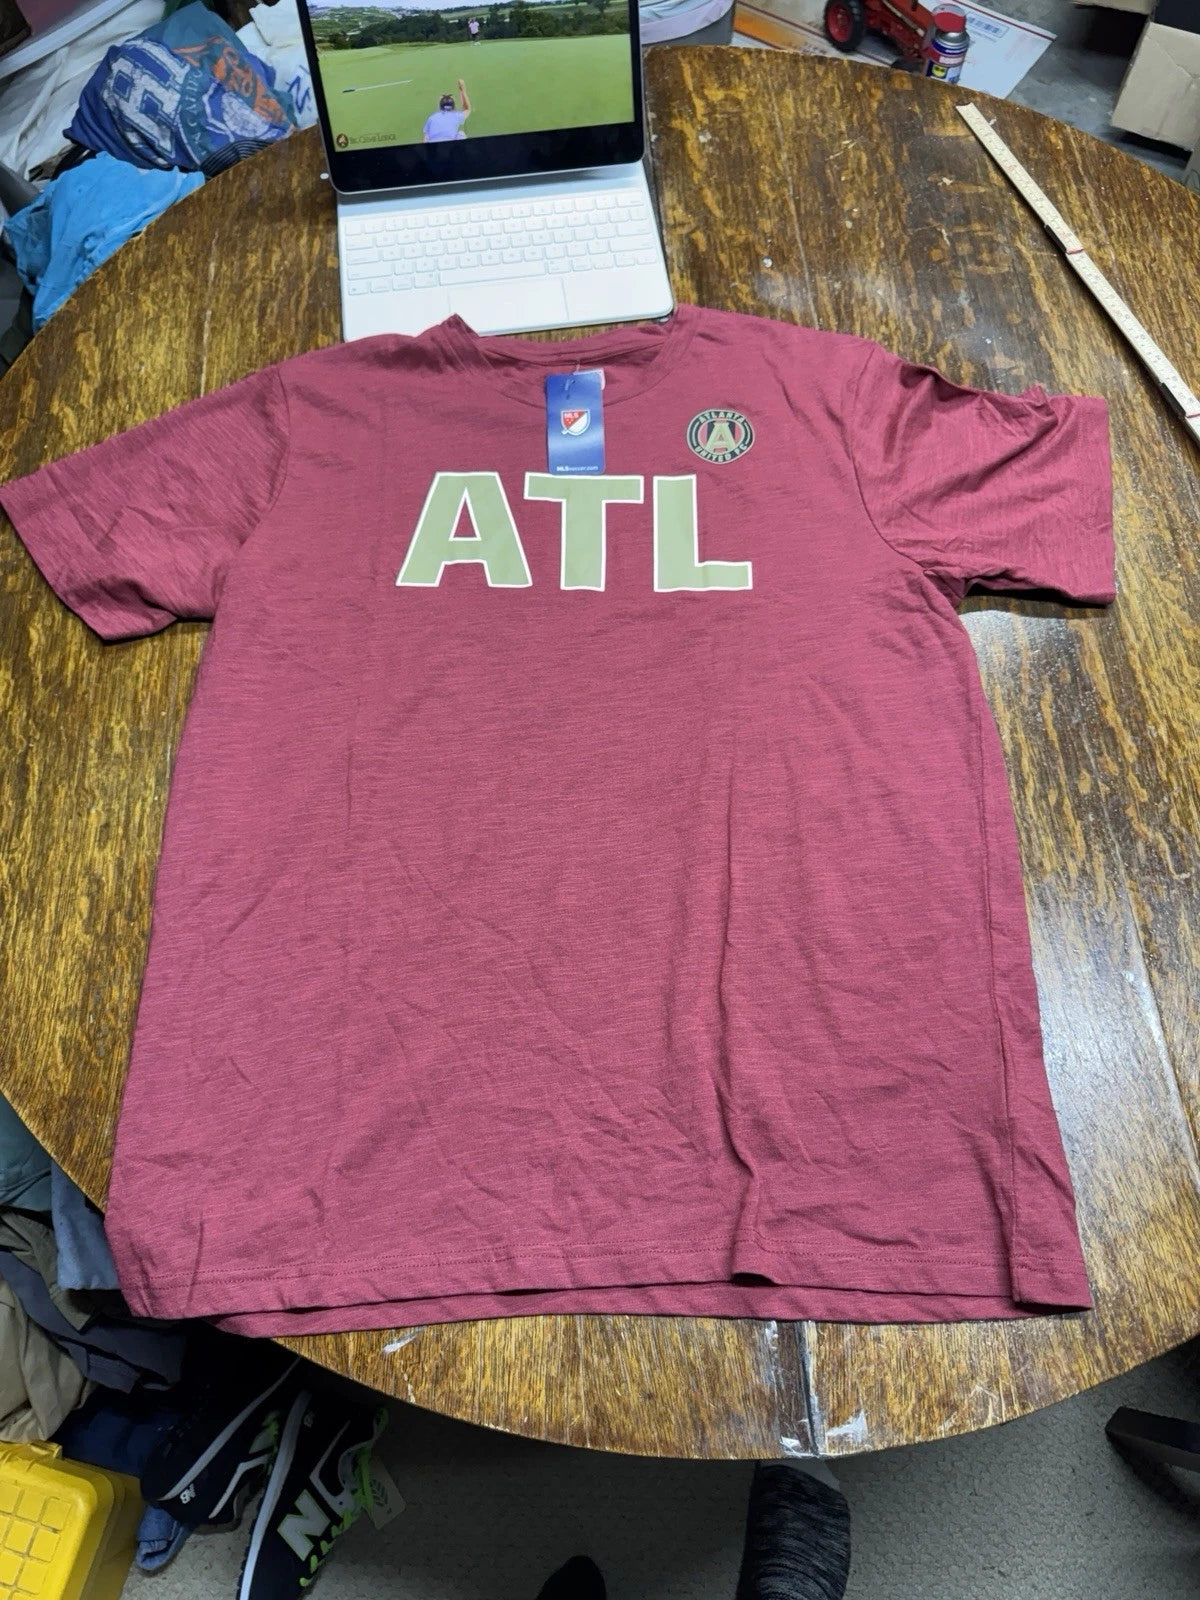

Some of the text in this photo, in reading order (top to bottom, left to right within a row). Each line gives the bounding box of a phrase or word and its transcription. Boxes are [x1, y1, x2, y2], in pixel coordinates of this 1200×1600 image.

[699, 411, 745, 424] ATLANTA
[694, 445, 732, 462] UNITED
[395, 470, 753, 593] ATL
